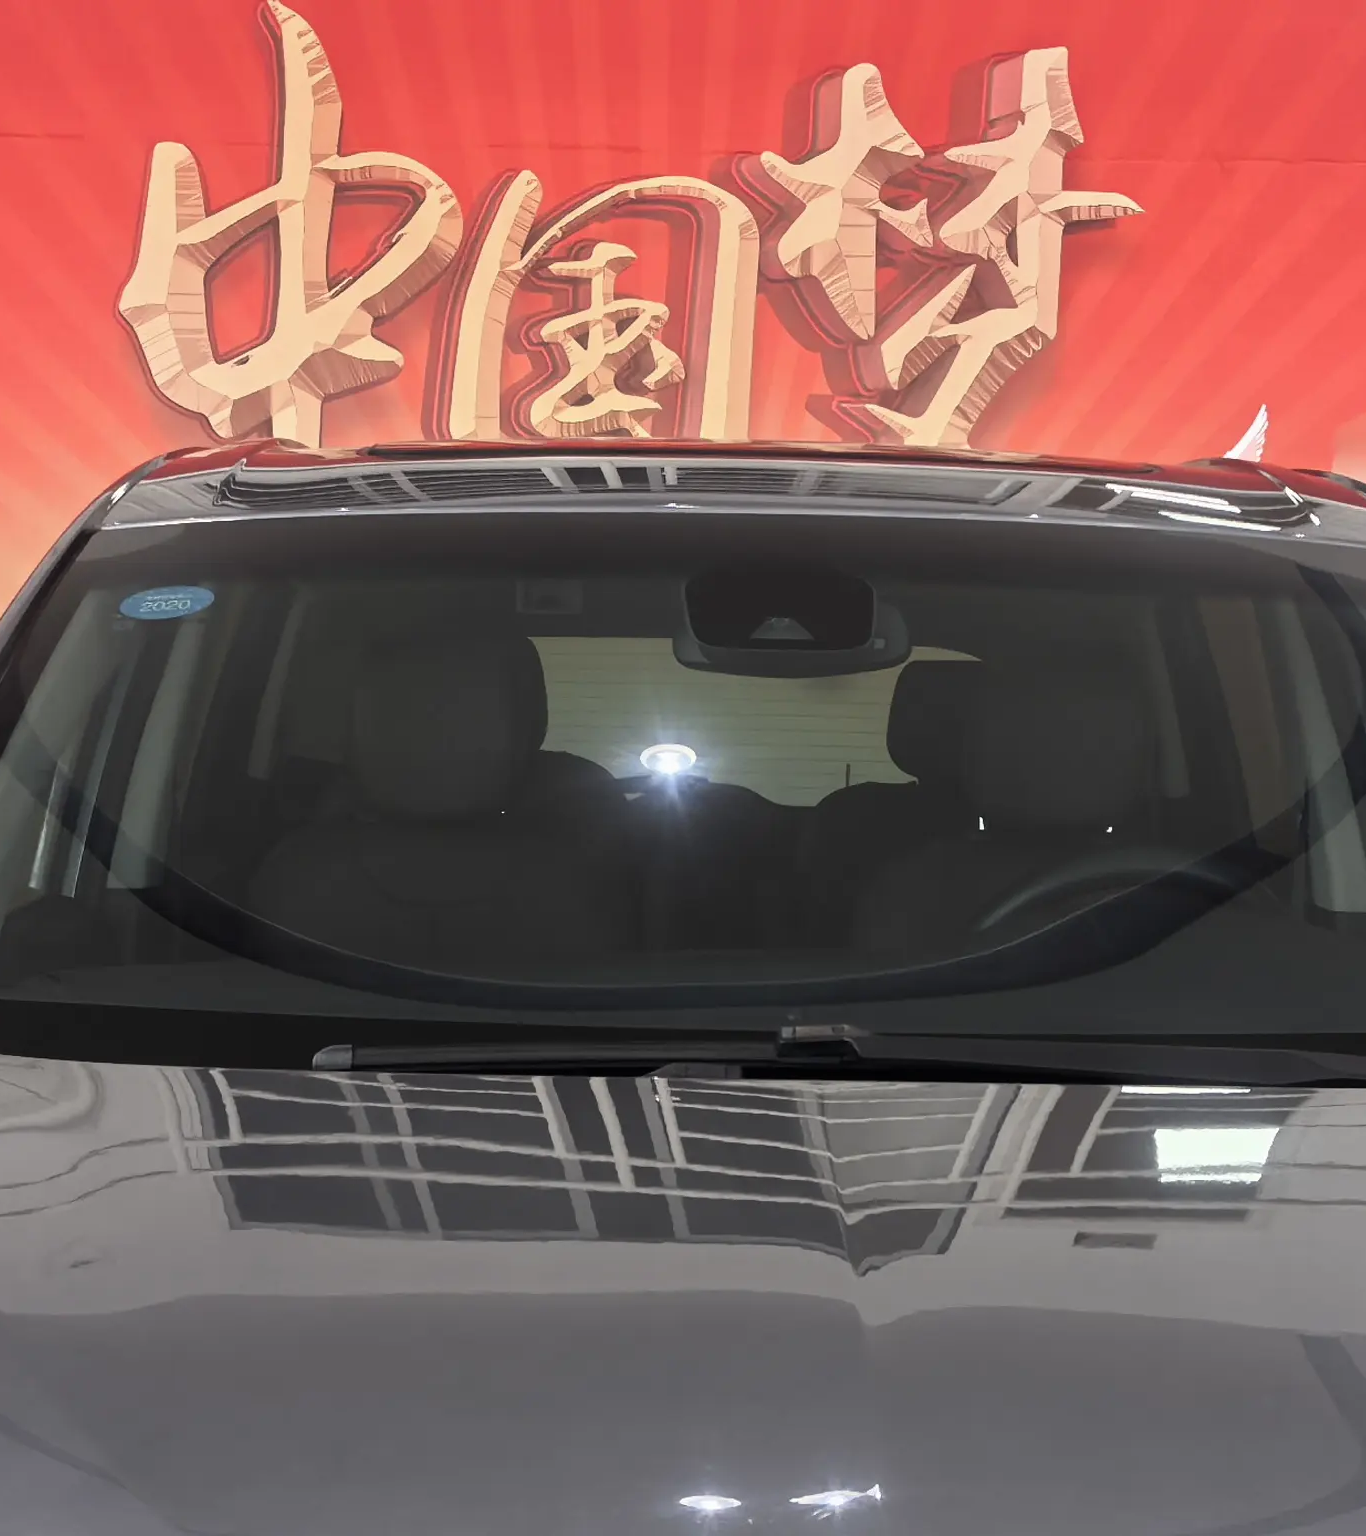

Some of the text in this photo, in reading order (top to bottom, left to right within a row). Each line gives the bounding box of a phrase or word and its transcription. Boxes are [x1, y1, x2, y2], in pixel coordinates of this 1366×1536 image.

[119, 0, 1145, 447] 中国梦
[139, 599, 191, 613] 2020
